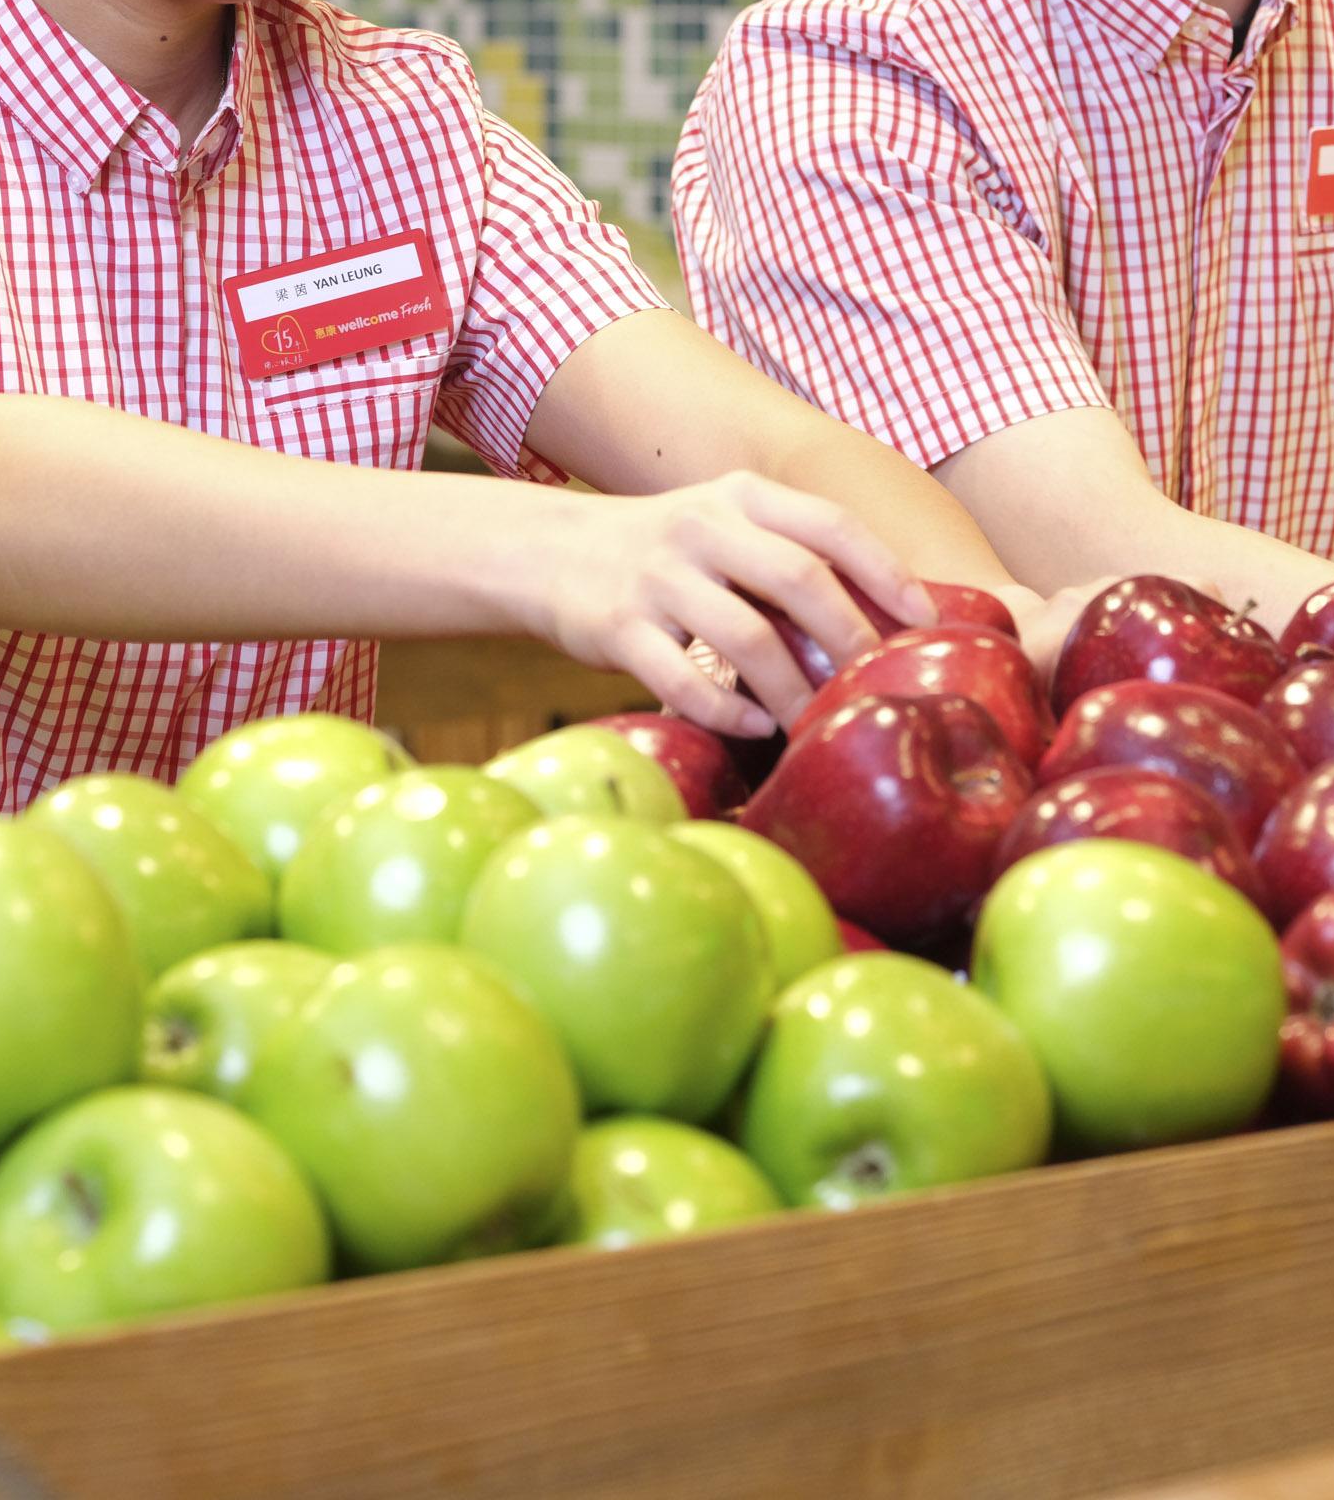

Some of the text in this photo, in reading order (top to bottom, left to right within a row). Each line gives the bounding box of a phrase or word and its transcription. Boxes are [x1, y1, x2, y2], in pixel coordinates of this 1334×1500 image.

[313, 275, 339, 290] YAN
[341, 263, 383, 283] LEUNG
[338, 309, 399, 334] wellcome
[400, 296, 433, 319] Fresh
